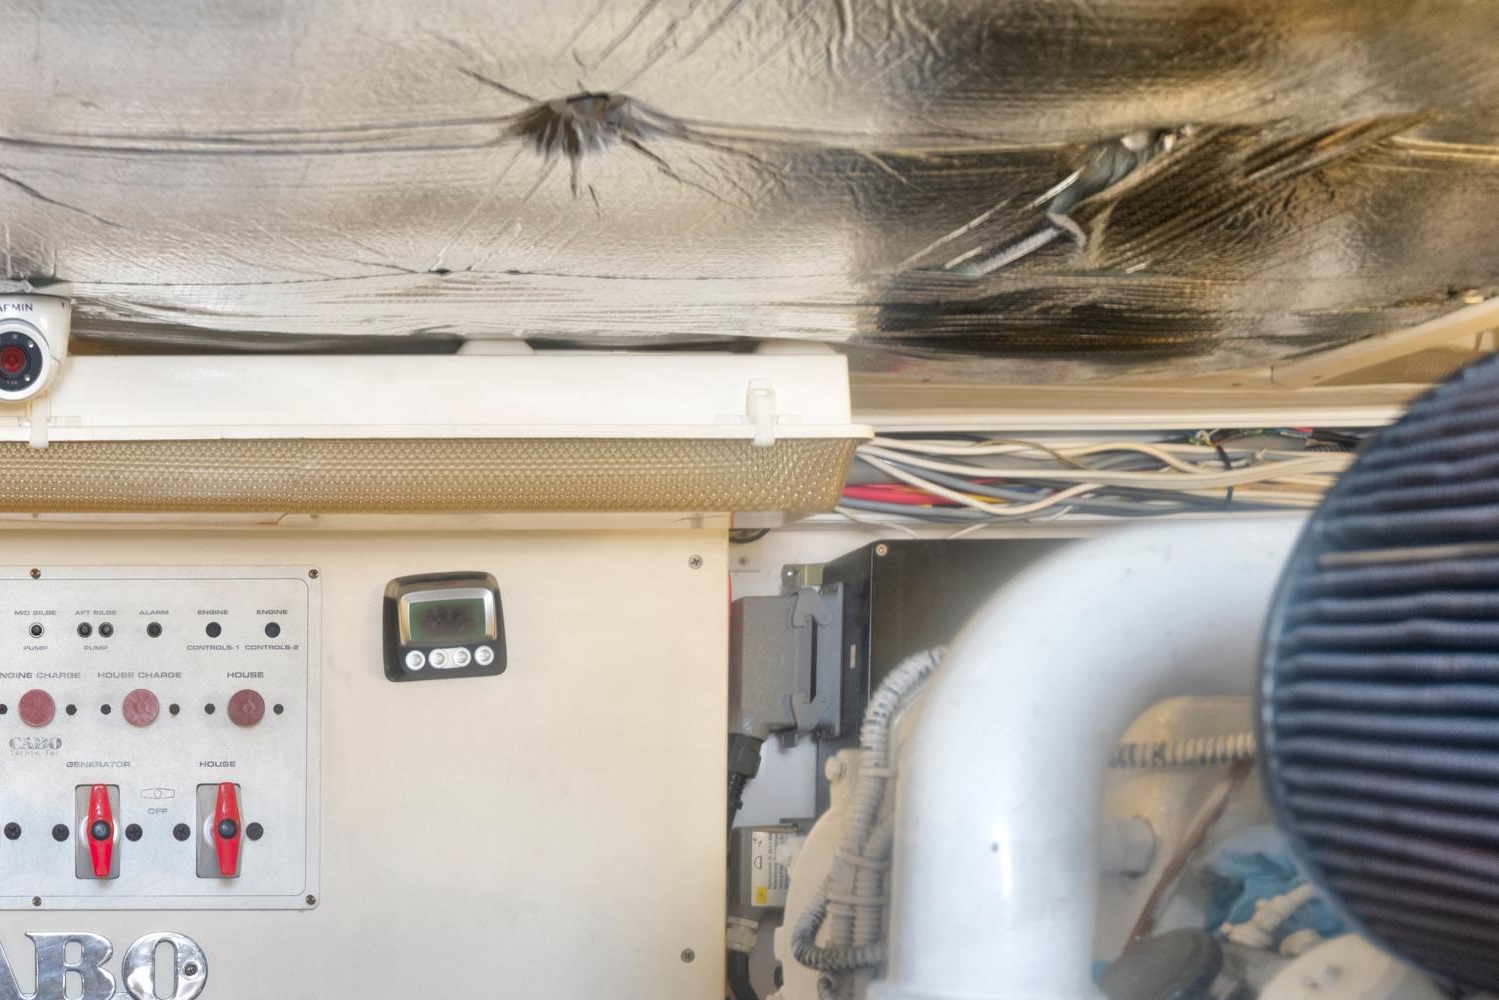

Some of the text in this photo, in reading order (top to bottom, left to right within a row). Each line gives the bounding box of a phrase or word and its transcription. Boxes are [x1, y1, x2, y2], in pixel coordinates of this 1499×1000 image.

[35, 672, 81, 680] CHARGE
[98, 672, 182, 680] HOUSE CHARGE
